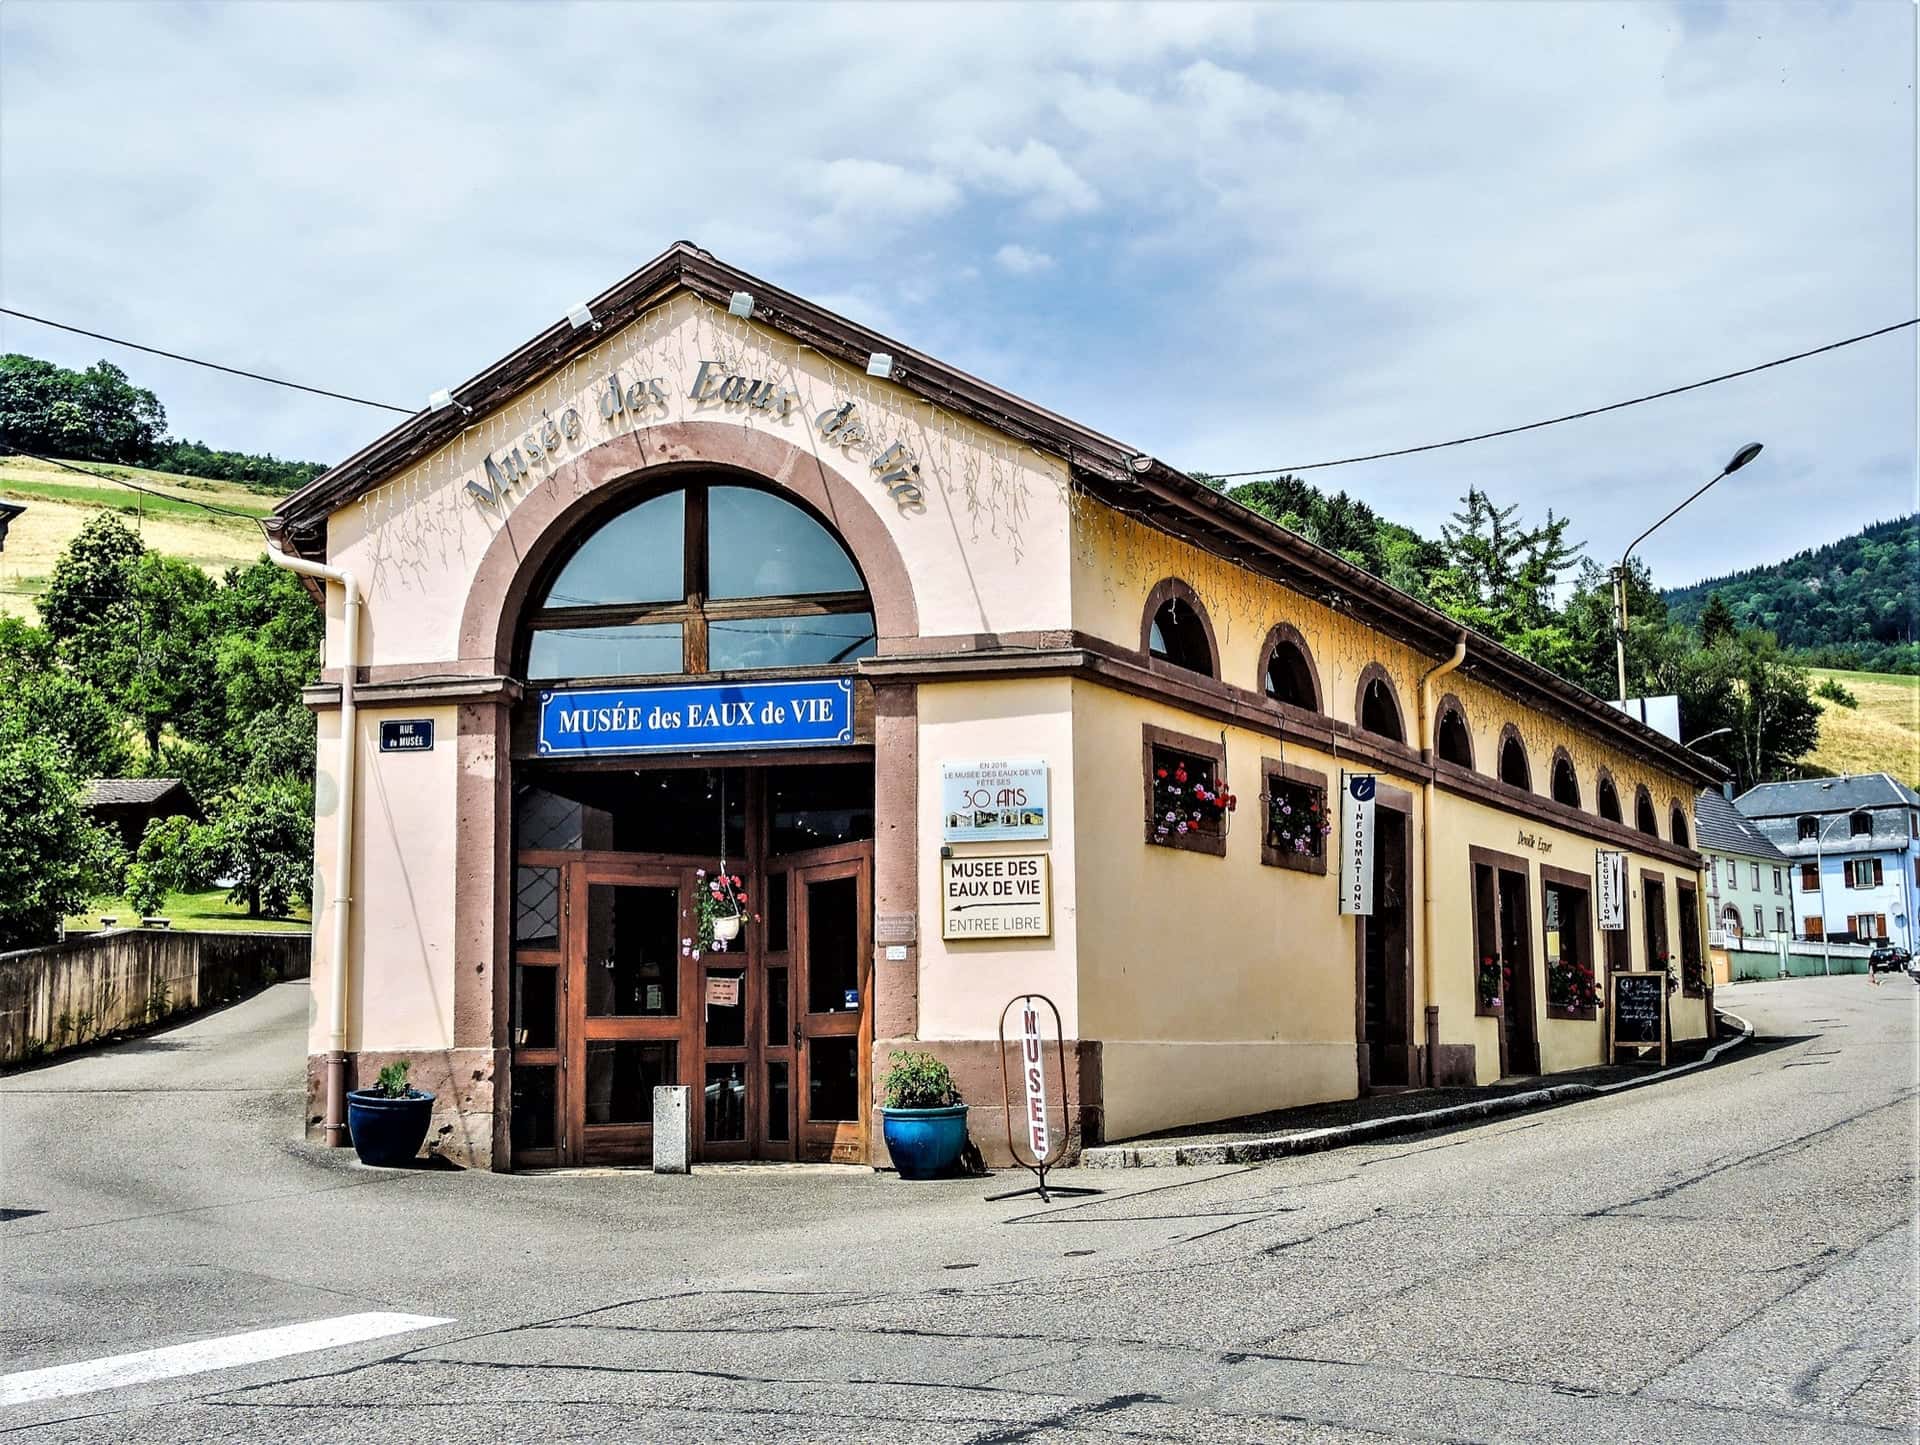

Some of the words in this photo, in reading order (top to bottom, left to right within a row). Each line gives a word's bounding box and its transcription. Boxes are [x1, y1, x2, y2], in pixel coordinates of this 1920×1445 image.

[463, 408, 580, 506] Musée
[600, 373, 672, 420] des
[687, 360, 800, 415] Eaux
[815, 401, 866, 438] de
[559, 701, 641, 733] MUSÉE
[648, 706, 681, 730] des
[687, 702, 755, 727] EAUX
[761, 701, 785, 724] de
[794, 698, 833, 722] VIE
[400, 725, 414, 734] RUE
[982, 770, 997, 778] DES
[998, 769, 1018, 777] EAUX
[962, 789, 991, 808] 30
[996, 787, 1027, 807] ANS
[1353, 803, 1363, 910] INFORMATIONS
[951, 863, 1004, 878] MUSEE
[1008, 861, 1038, 876] DES
[949, 882, 990, 897] EAUX
[993, 881, 1013, 895] DE
[1016, 880, 1040, 895] VIE
[949, 917, 1000, 932] ENTREE
[1003, 917, 1041, 931] LIBRE
[1024, 1010, 1045, 1151] MUSEE
